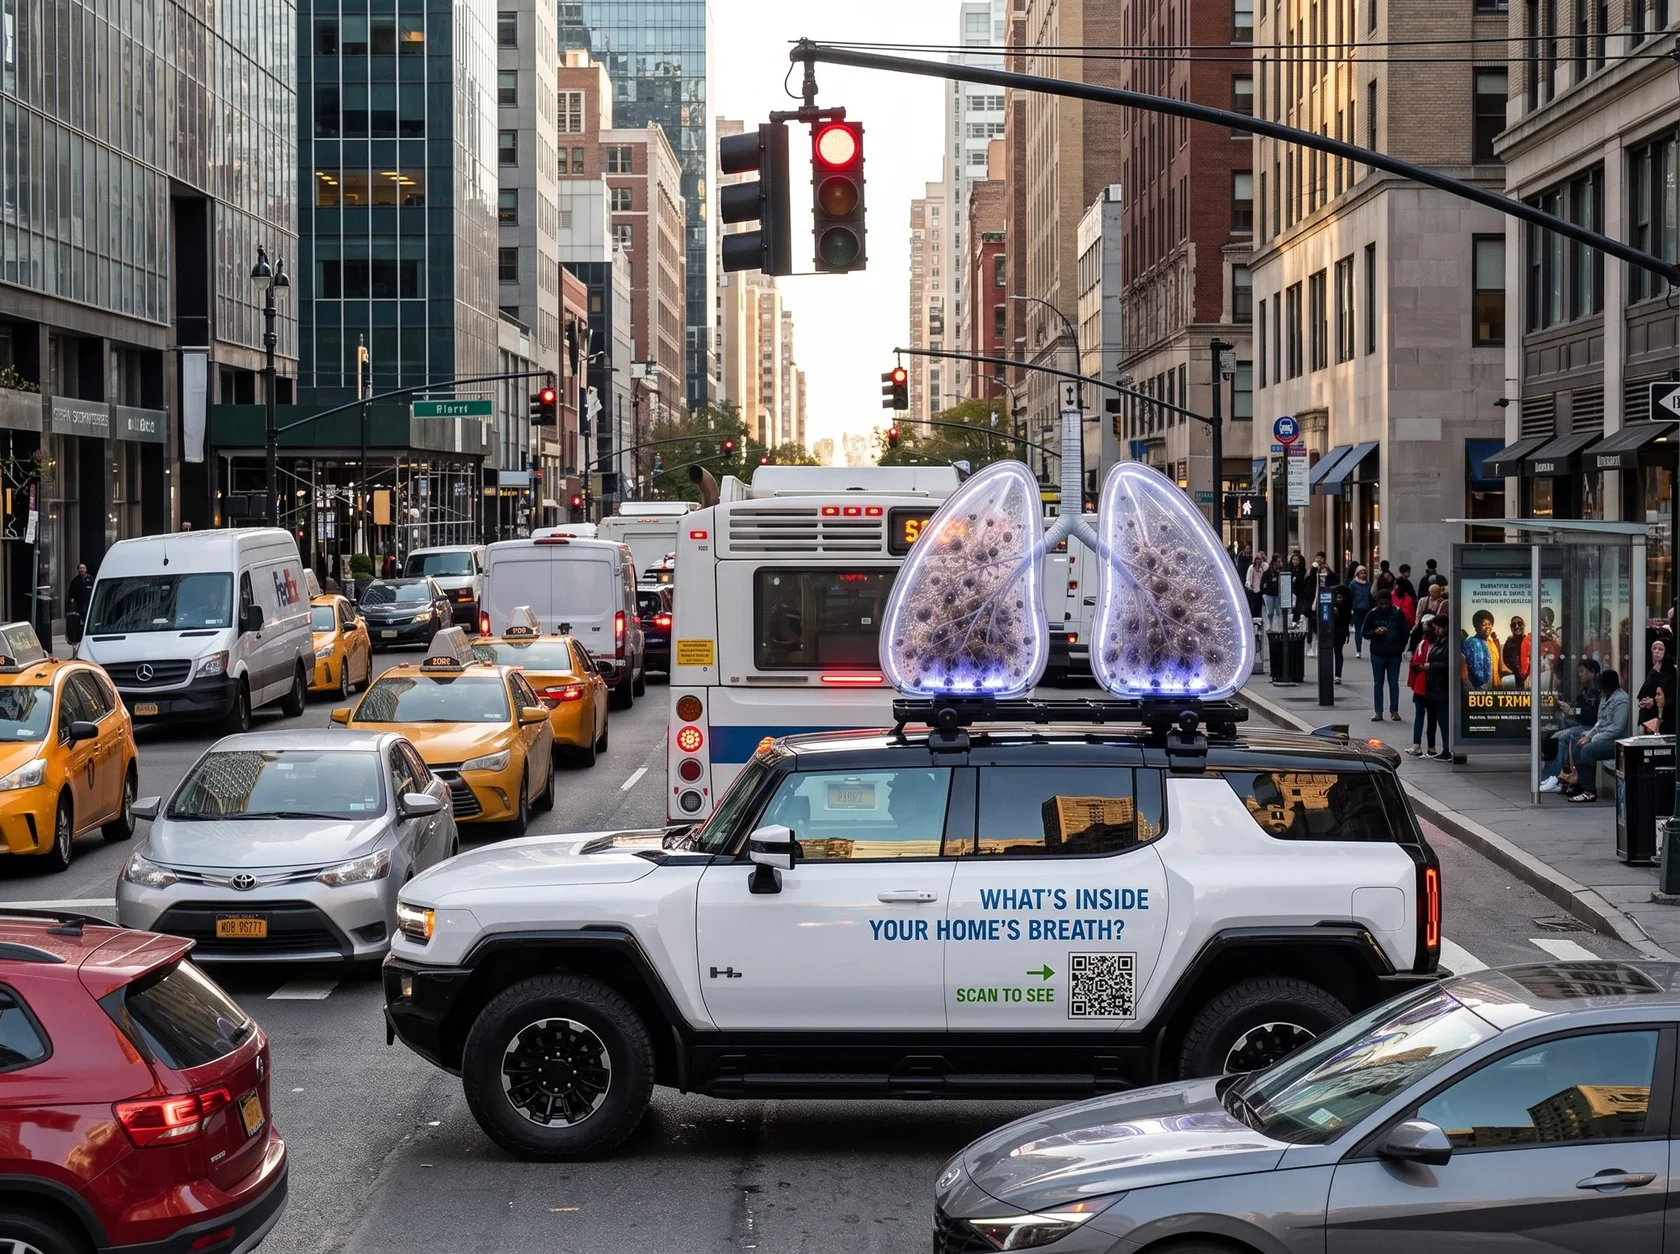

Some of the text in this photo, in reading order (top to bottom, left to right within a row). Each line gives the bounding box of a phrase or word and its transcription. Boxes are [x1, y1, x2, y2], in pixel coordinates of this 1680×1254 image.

[272, 569, 300, 607] FedEx
[1468, 695, 1494, 707] BUG
[979, 888, 1149, 910] WHAT'S INSIDE
[869, 919, 1126, 941] YOUR HOME'S BREATH?
[956, 987, 1055, 1003] SCAN TO SEE
